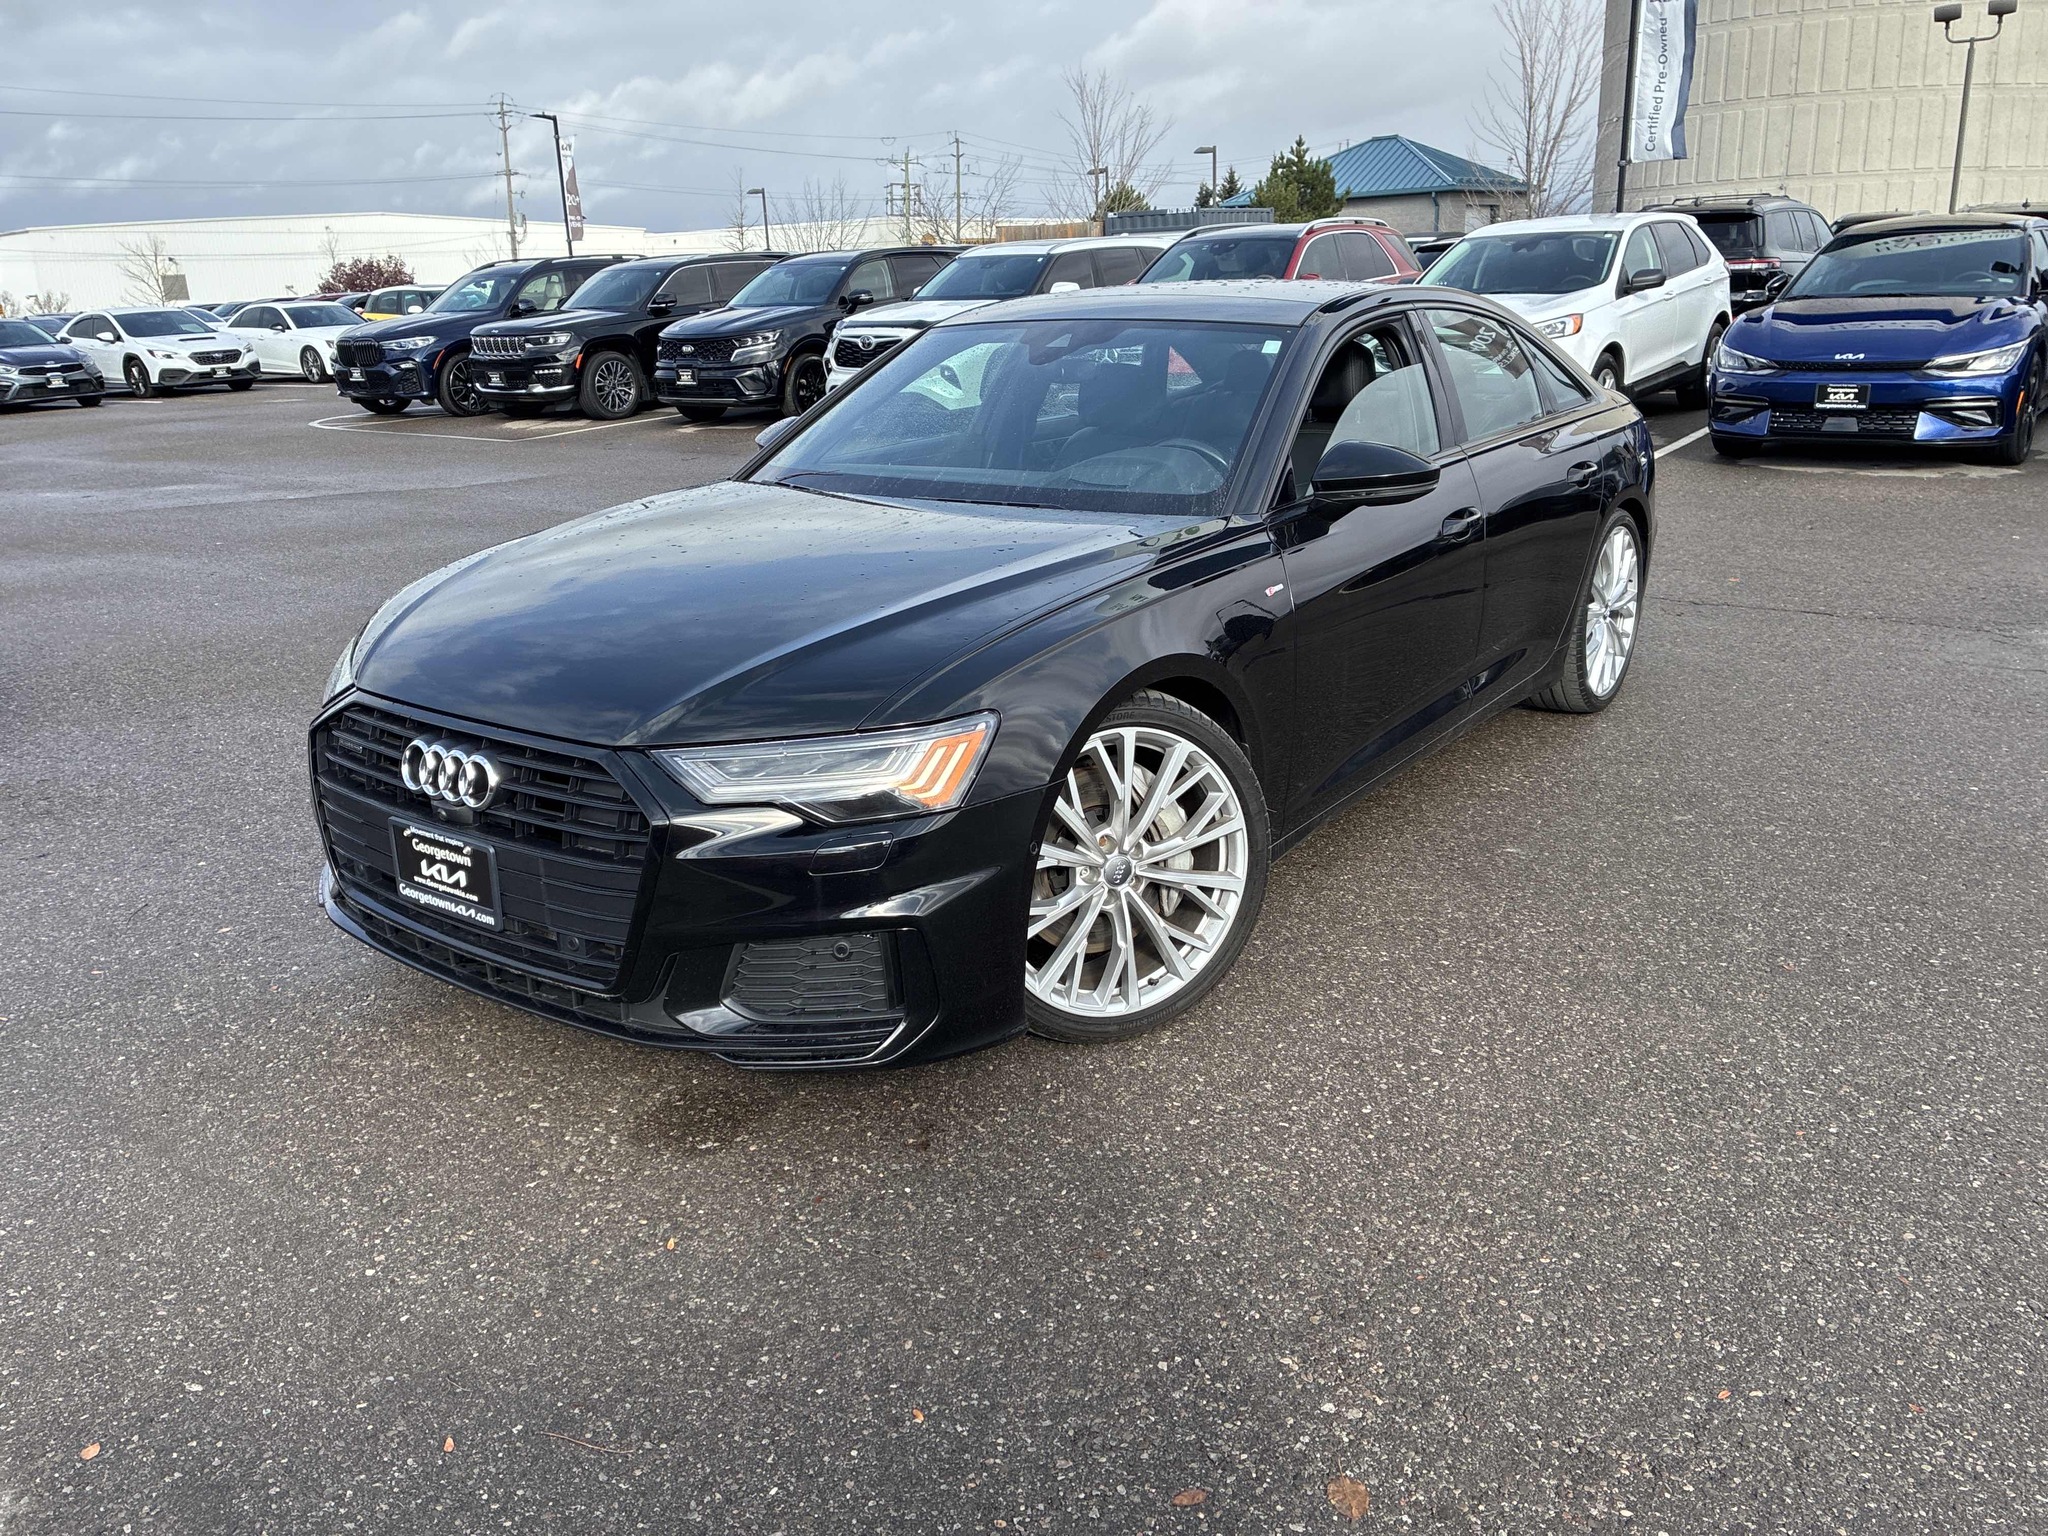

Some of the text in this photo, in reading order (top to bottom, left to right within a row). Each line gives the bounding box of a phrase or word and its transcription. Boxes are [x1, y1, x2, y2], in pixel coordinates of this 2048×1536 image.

[1654, 17, 1669, 93] Pre-Owned
[1645, 96, 1664, 152] Certified
[412, 838, 472, 867] Georgetown
[420, 858, 467, 888] KIA
